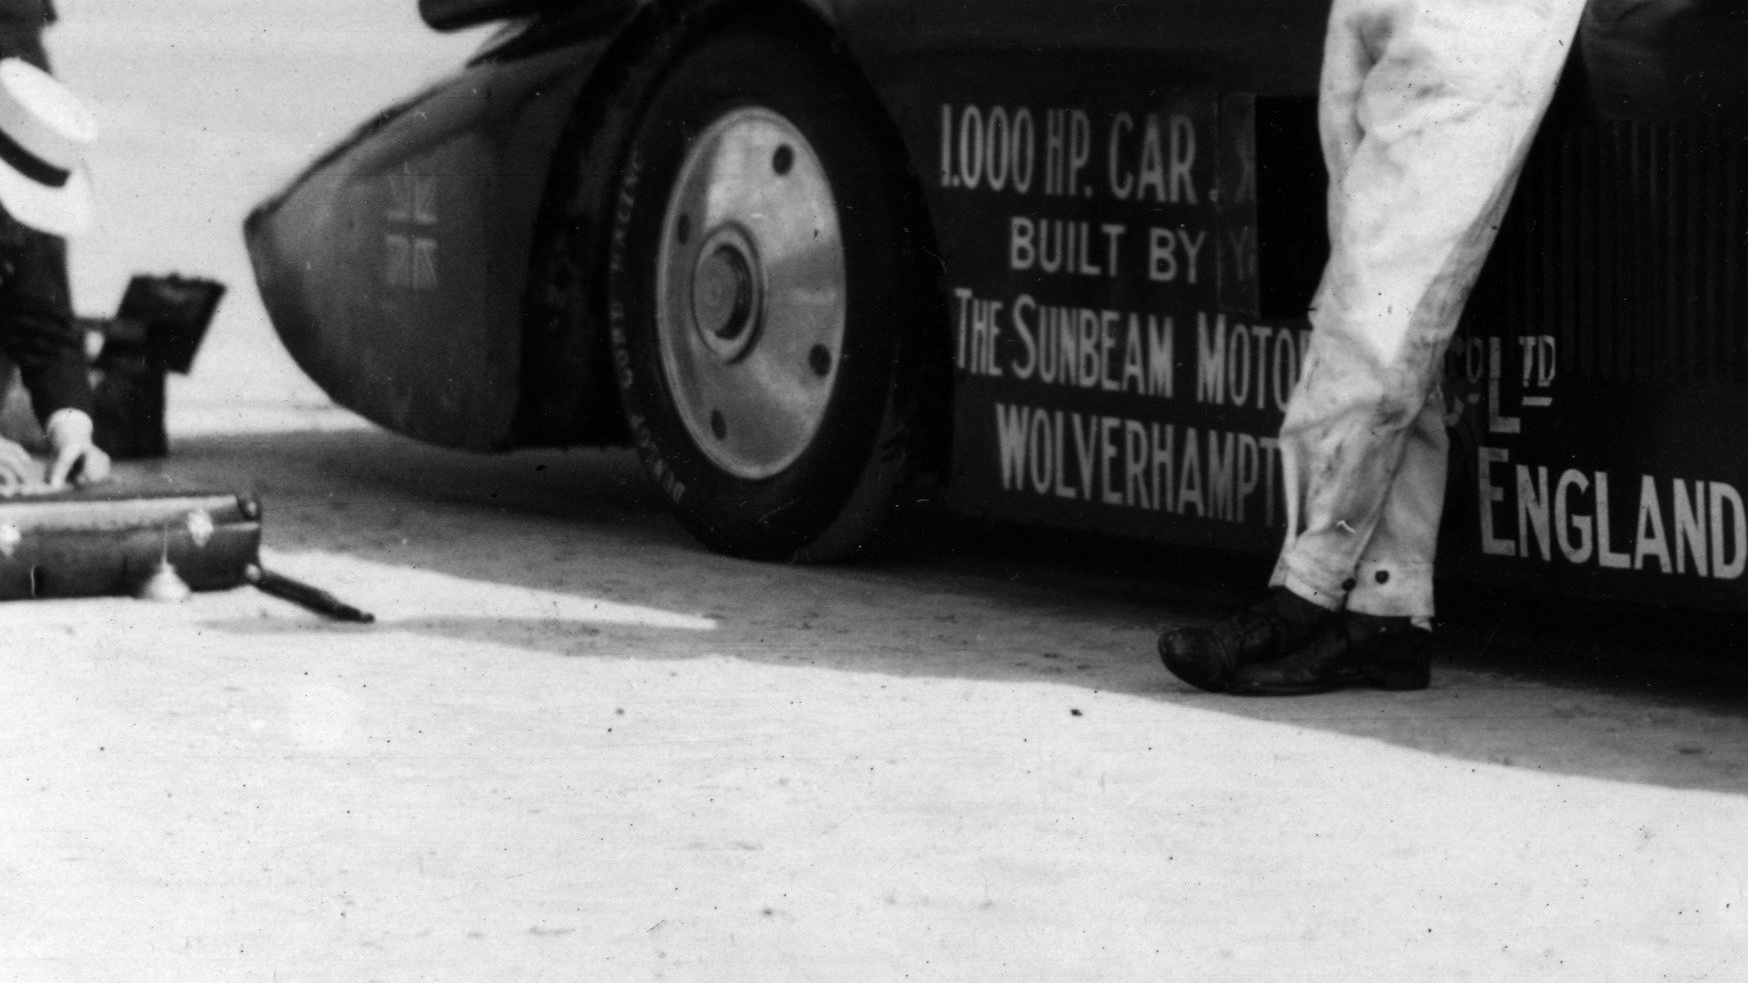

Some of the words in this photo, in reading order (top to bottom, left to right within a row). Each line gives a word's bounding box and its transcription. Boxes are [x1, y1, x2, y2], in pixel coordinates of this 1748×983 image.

[1010, 215, 1128, 279] BUILT
[1148, 226, 1207, 284] BY
[954, 287, 1004, 377] THE
[1011, 293, 1174, 400] SUNBEAM
[1488, 334, 1557, 434] LTD
[1478, 446, 1748, 581] ENGLAND
